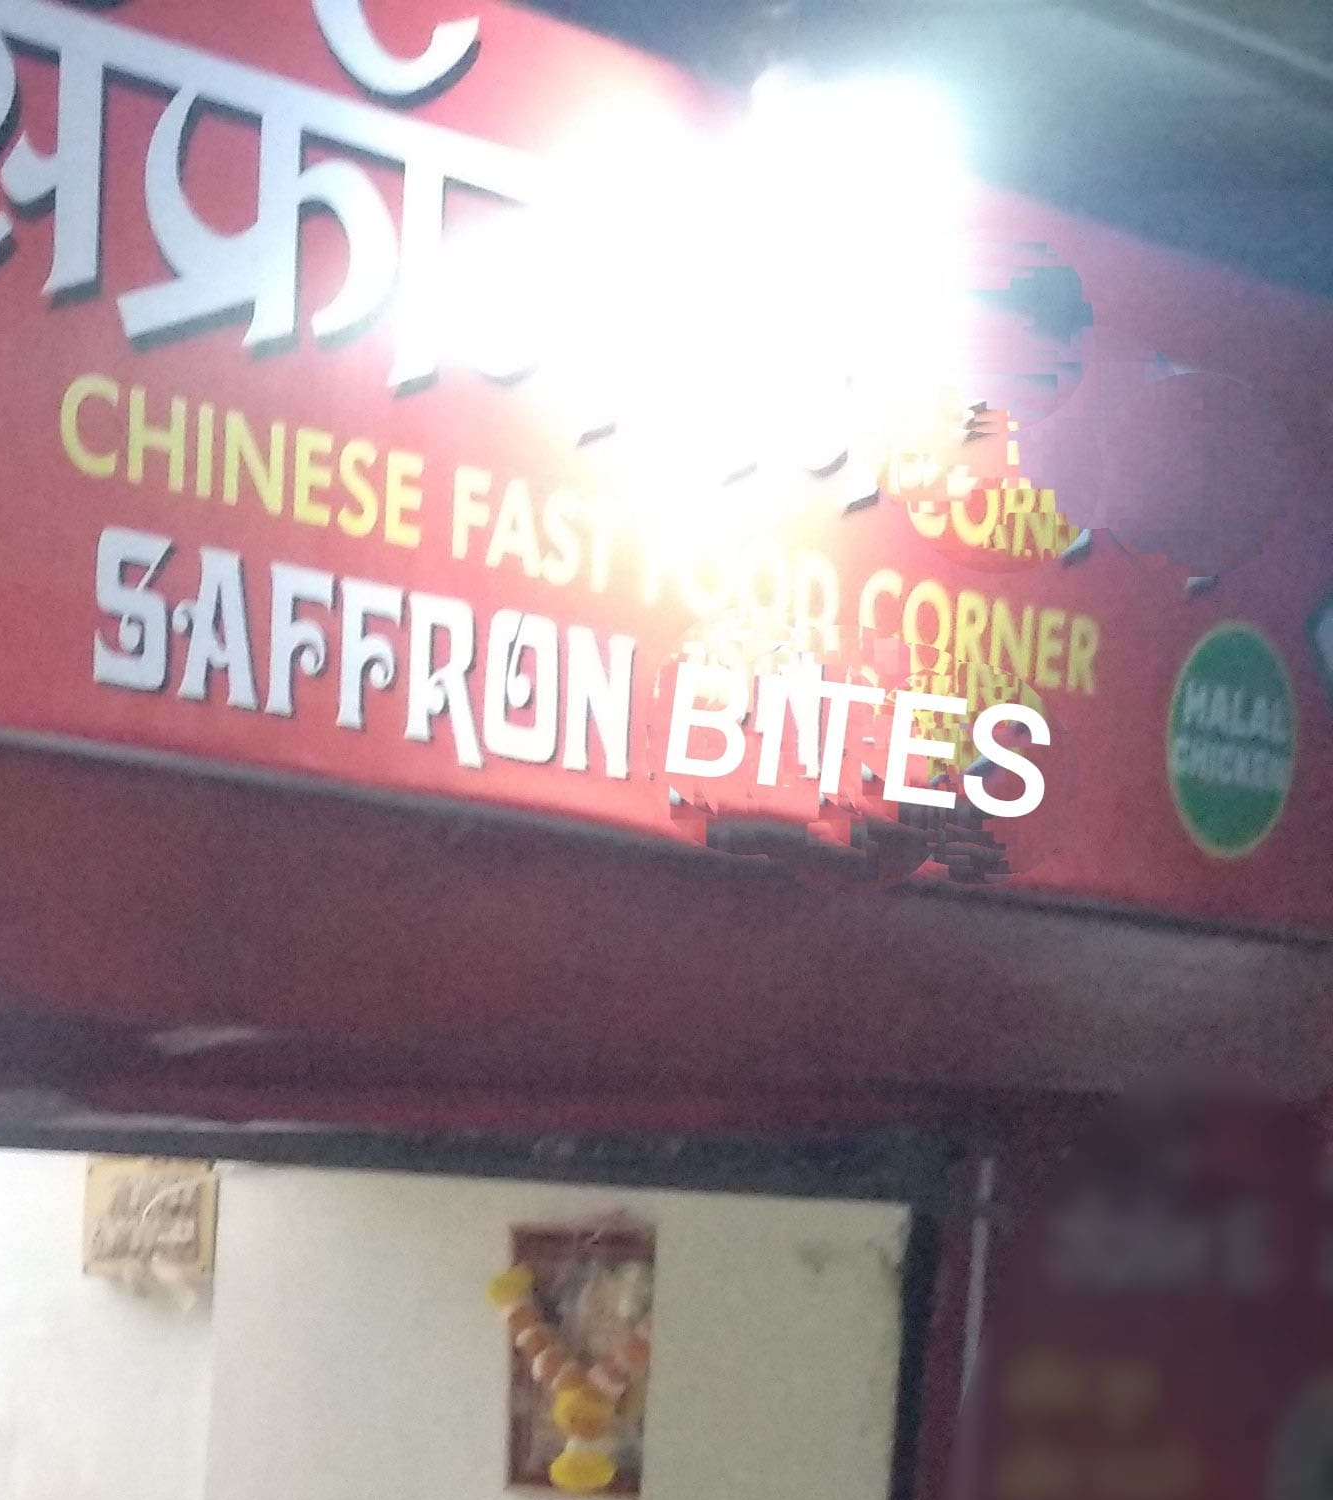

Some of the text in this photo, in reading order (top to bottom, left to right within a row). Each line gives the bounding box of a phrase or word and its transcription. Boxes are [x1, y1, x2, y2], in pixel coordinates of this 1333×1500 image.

[59, 372, 426, 548] CHINESE
[451, 463, 617, 595] FAST
[859, 568, 1100, 695] CORNER
[93, 525, 636, 782] SAFFRON
